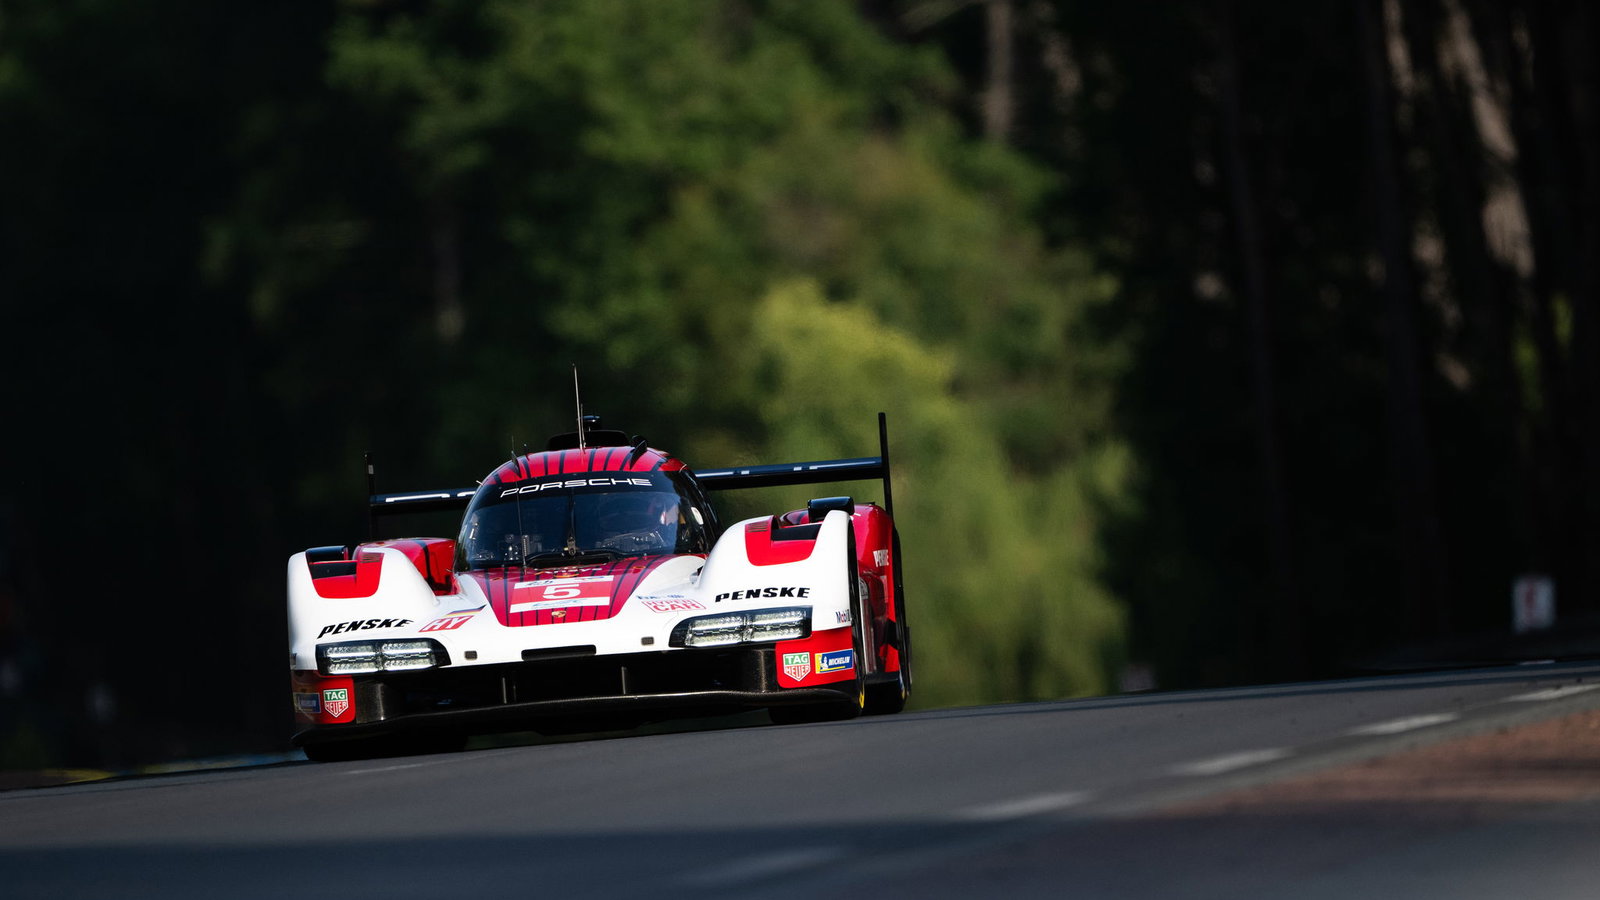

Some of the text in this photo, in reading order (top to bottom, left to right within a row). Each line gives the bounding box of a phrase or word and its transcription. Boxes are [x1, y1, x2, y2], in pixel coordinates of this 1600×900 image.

[500, 478, 652, 498] PORSCHE
[543, 583, 581, 599] 5
[715, 587, 810, 603] PENSKE
[653, 603, 700, 612] CAR
[317, 618, 414, 639] PENSKE
[785, 654, 808, 665] TAG
[784, 665, 810, 679] HEUER
[325, 691, 345, 700] TAG
[325, 701, 347, 715] HEUER
